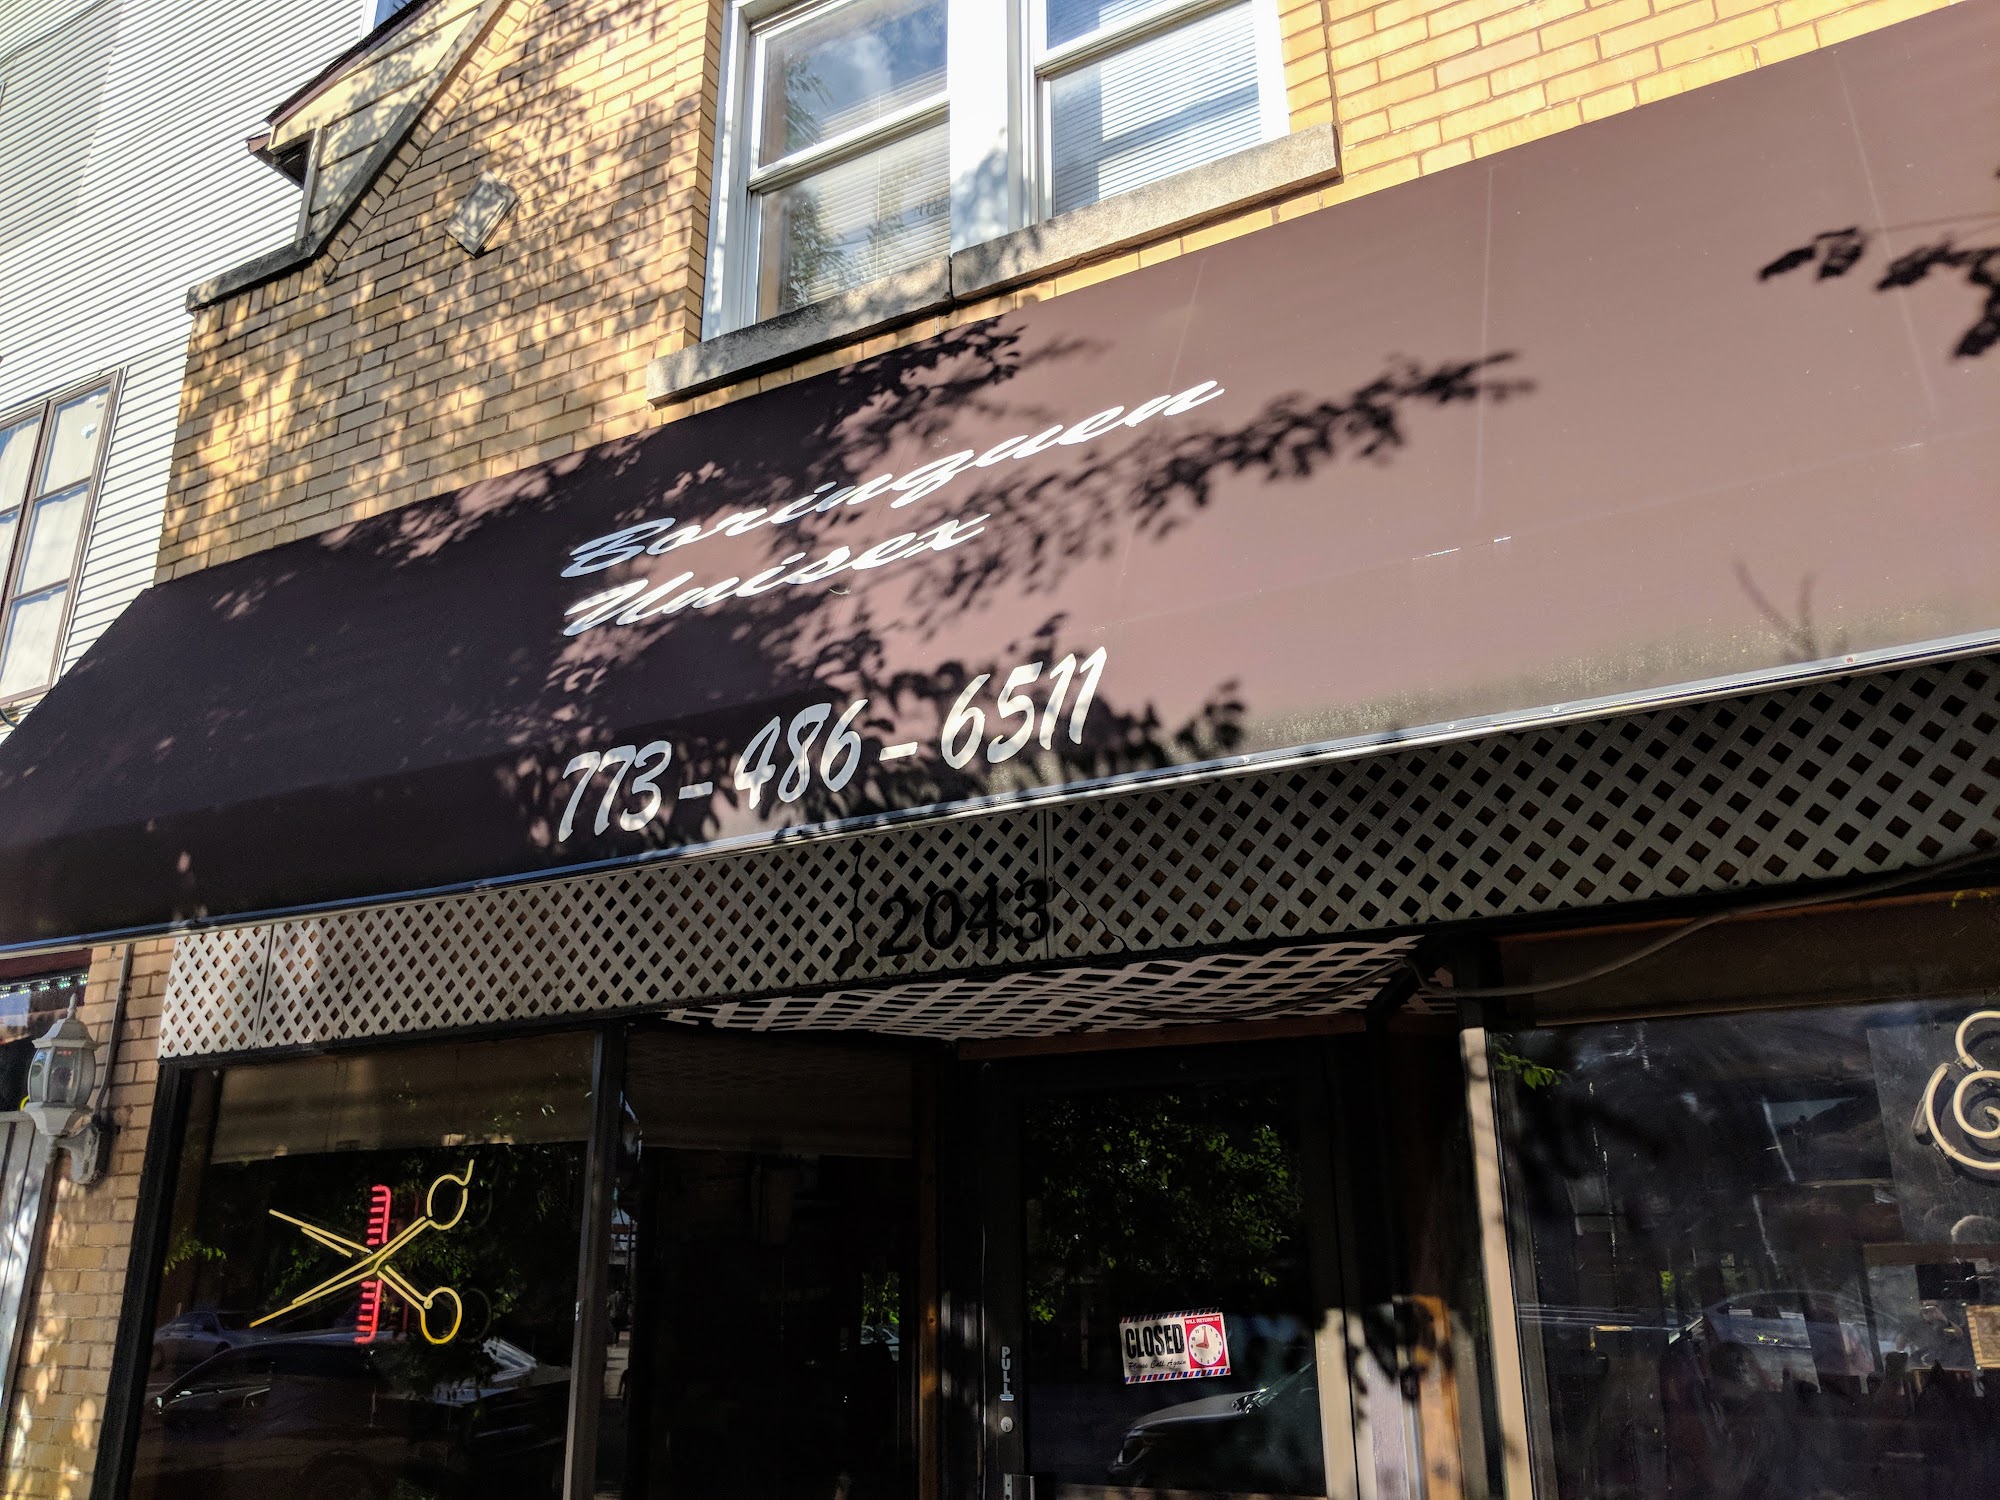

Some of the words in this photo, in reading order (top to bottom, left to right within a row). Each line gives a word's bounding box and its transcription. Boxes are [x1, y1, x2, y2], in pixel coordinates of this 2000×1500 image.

[562, 513, 991, 636] Unisex
[877, 879, 1052, 957] 2043
[1125, 1323, 1185, 1359] CLOSED
[1167, 1358, 1187, 1368] Again
[1001, 1346, 1011, 1394] PULL
